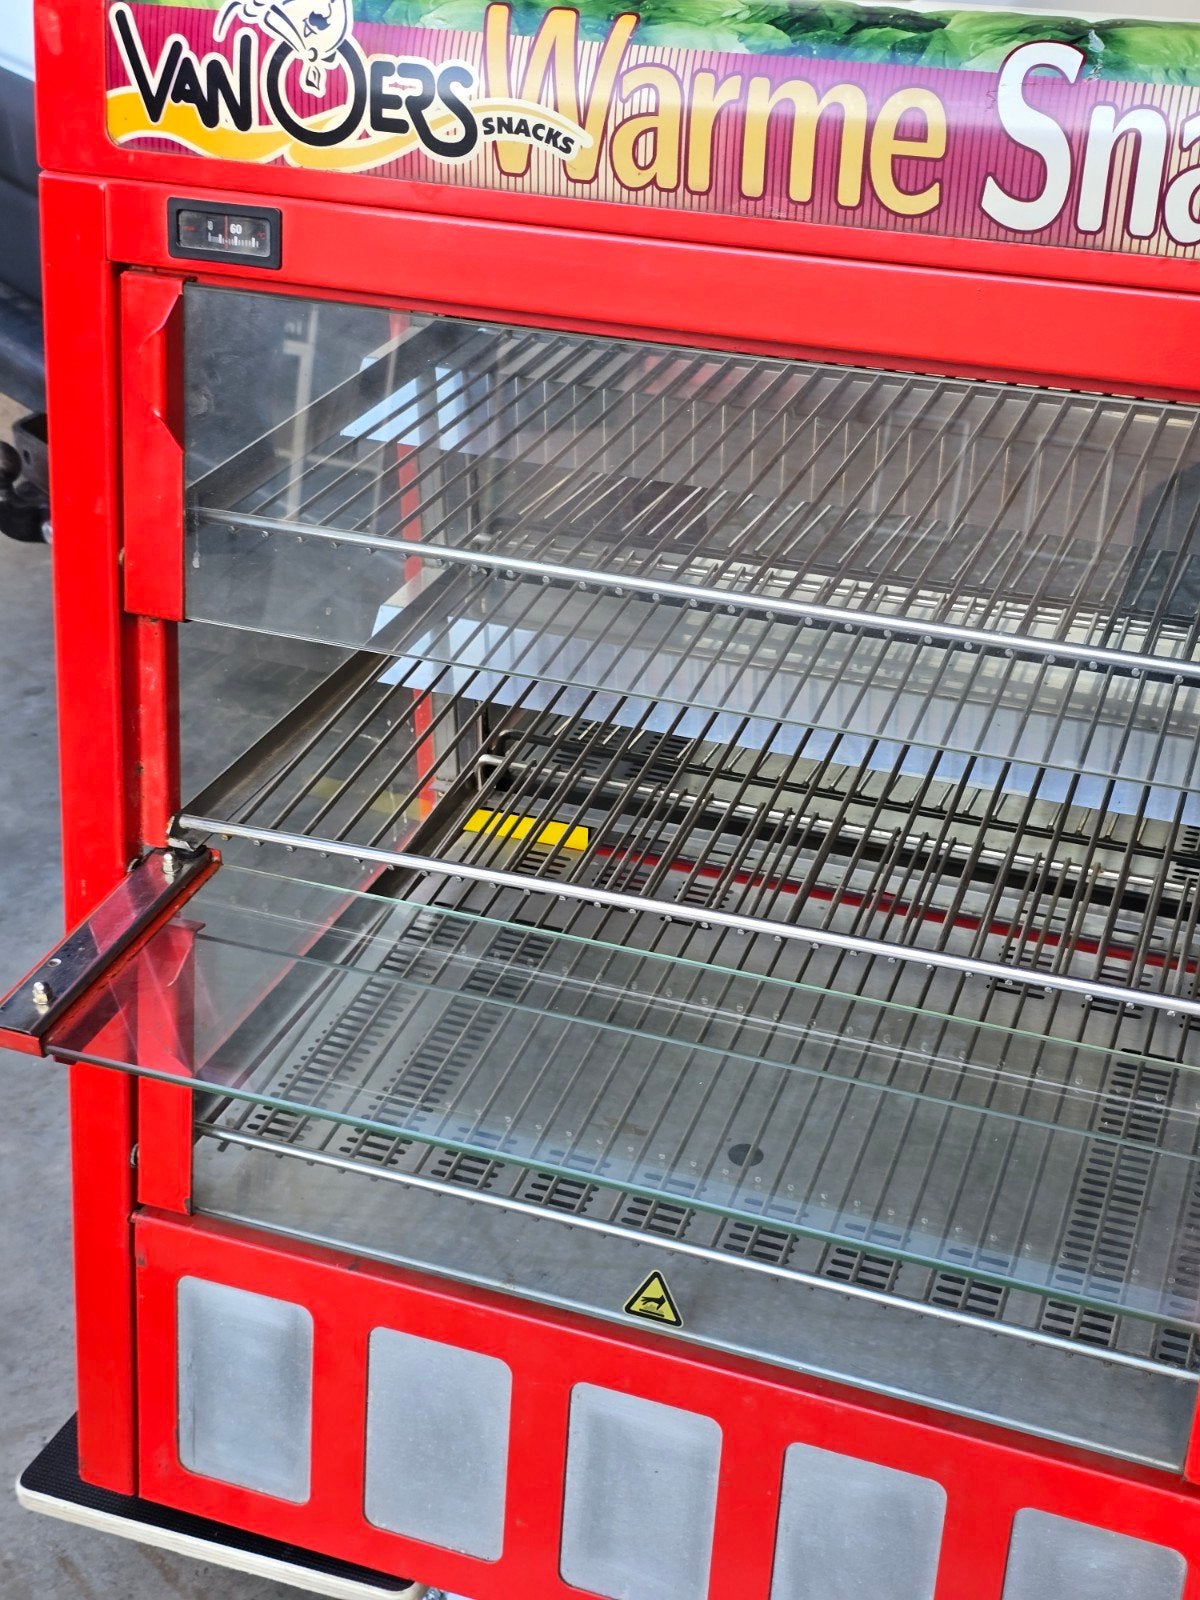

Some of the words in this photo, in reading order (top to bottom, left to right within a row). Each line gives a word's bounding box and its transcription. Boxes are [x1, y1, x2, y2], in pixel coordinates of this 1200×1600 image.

[115, 9, 252, 132] VAN
[483, 3, 948, 217] Warme
[482, 116, 575, 155] SNACKS
[229, 223, 243, 235] 60
